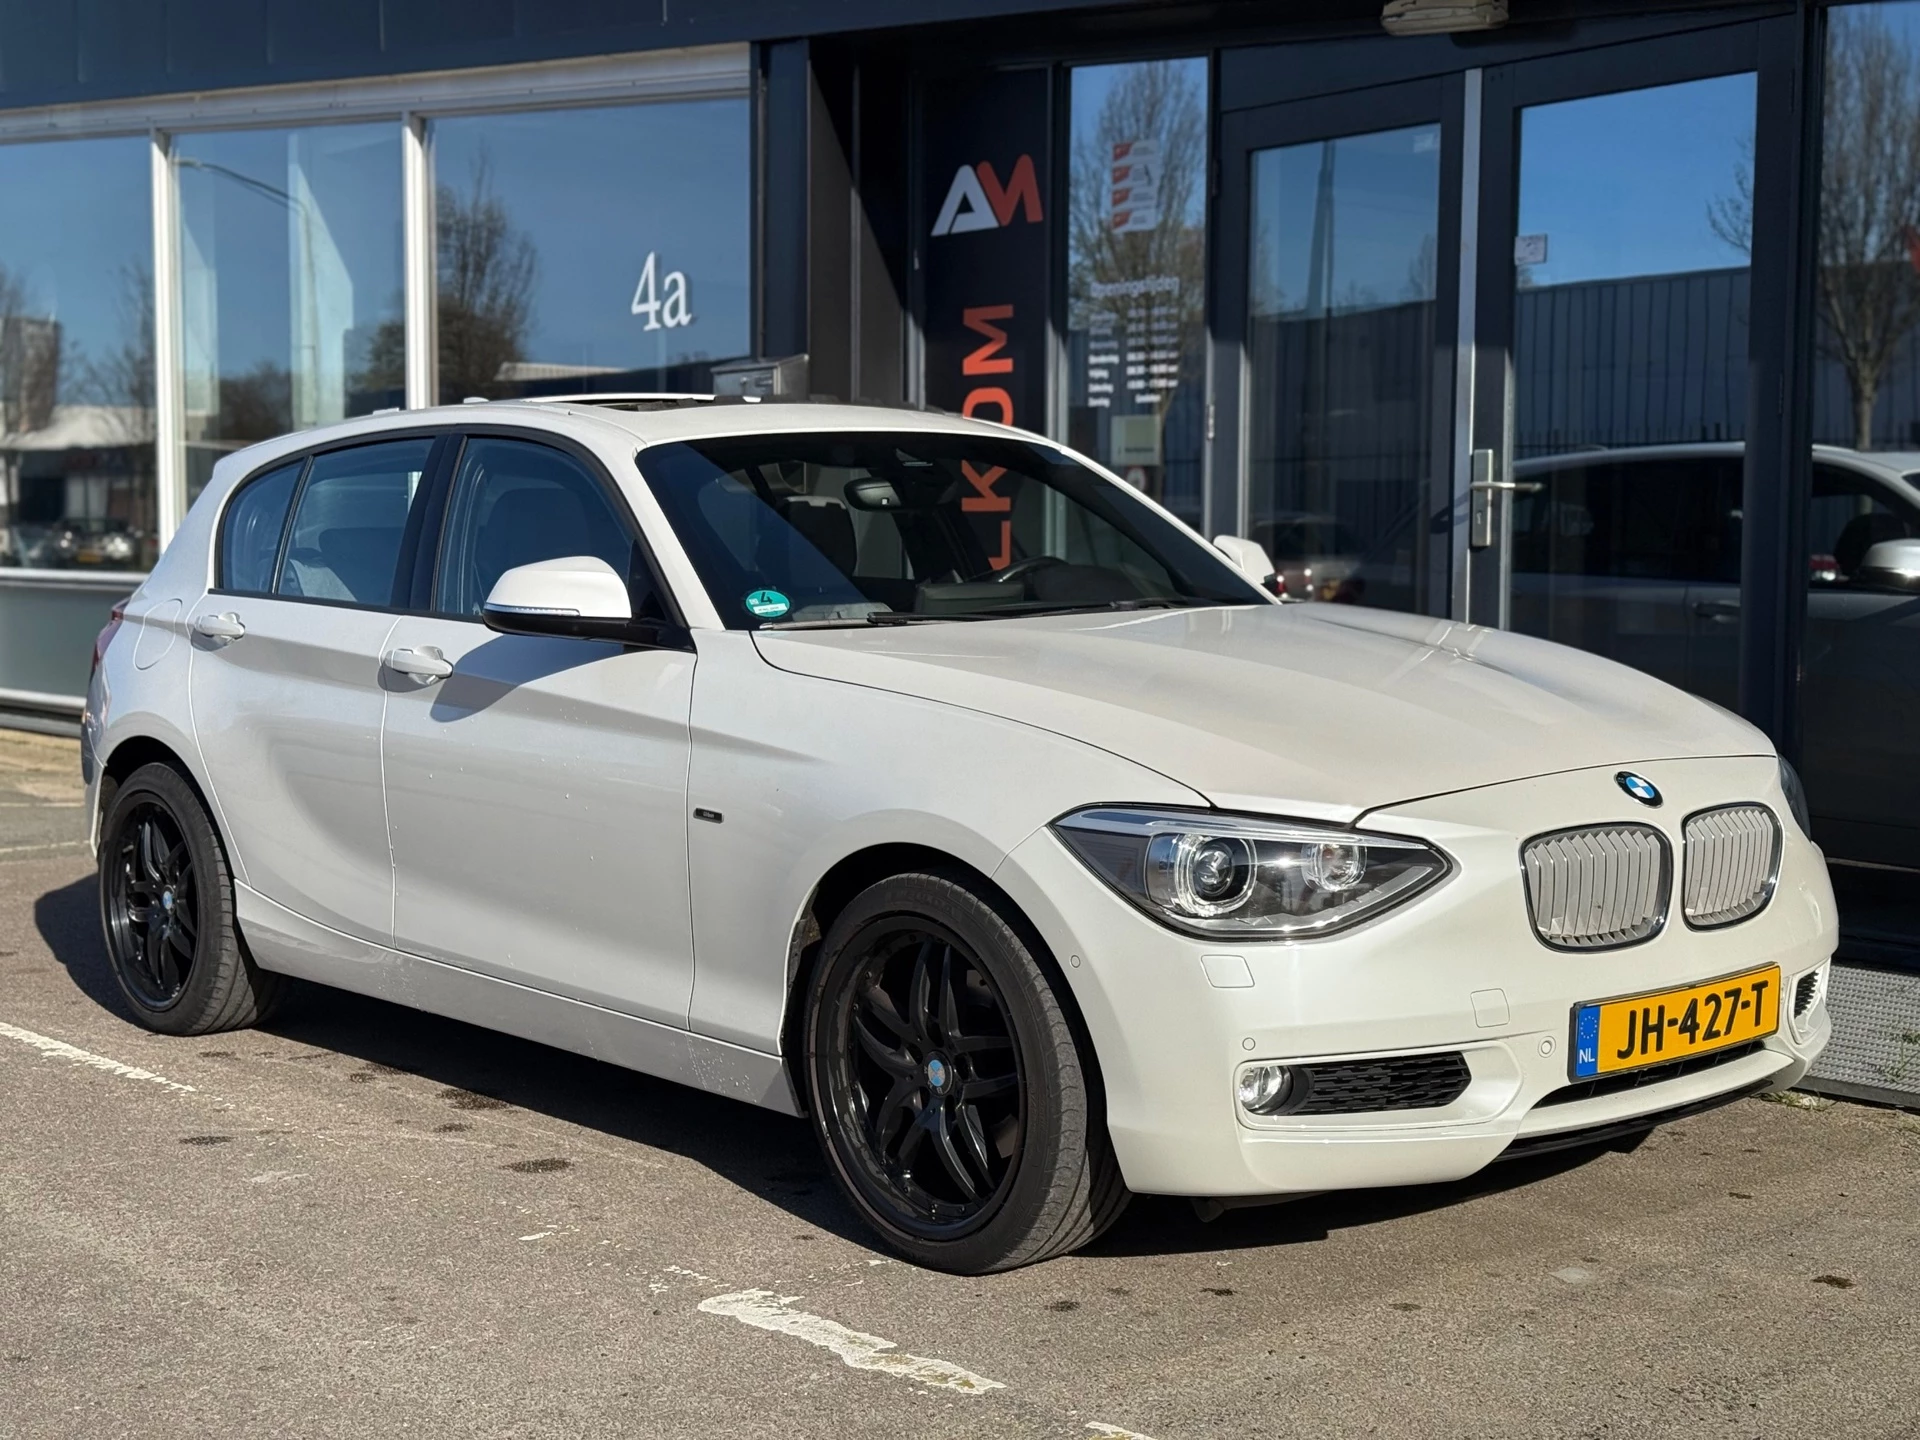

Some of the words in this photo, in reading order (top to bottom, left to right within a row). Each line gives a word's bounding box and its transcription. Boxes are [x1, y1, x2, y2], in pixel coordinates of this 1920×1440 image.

[930, 153, 1044, 237] AM
[631, 250, 692, 332] 4a
[1579, 1048, 1596, 1065] NL
[1617, 980, 1769, 1060] JH-427-T
